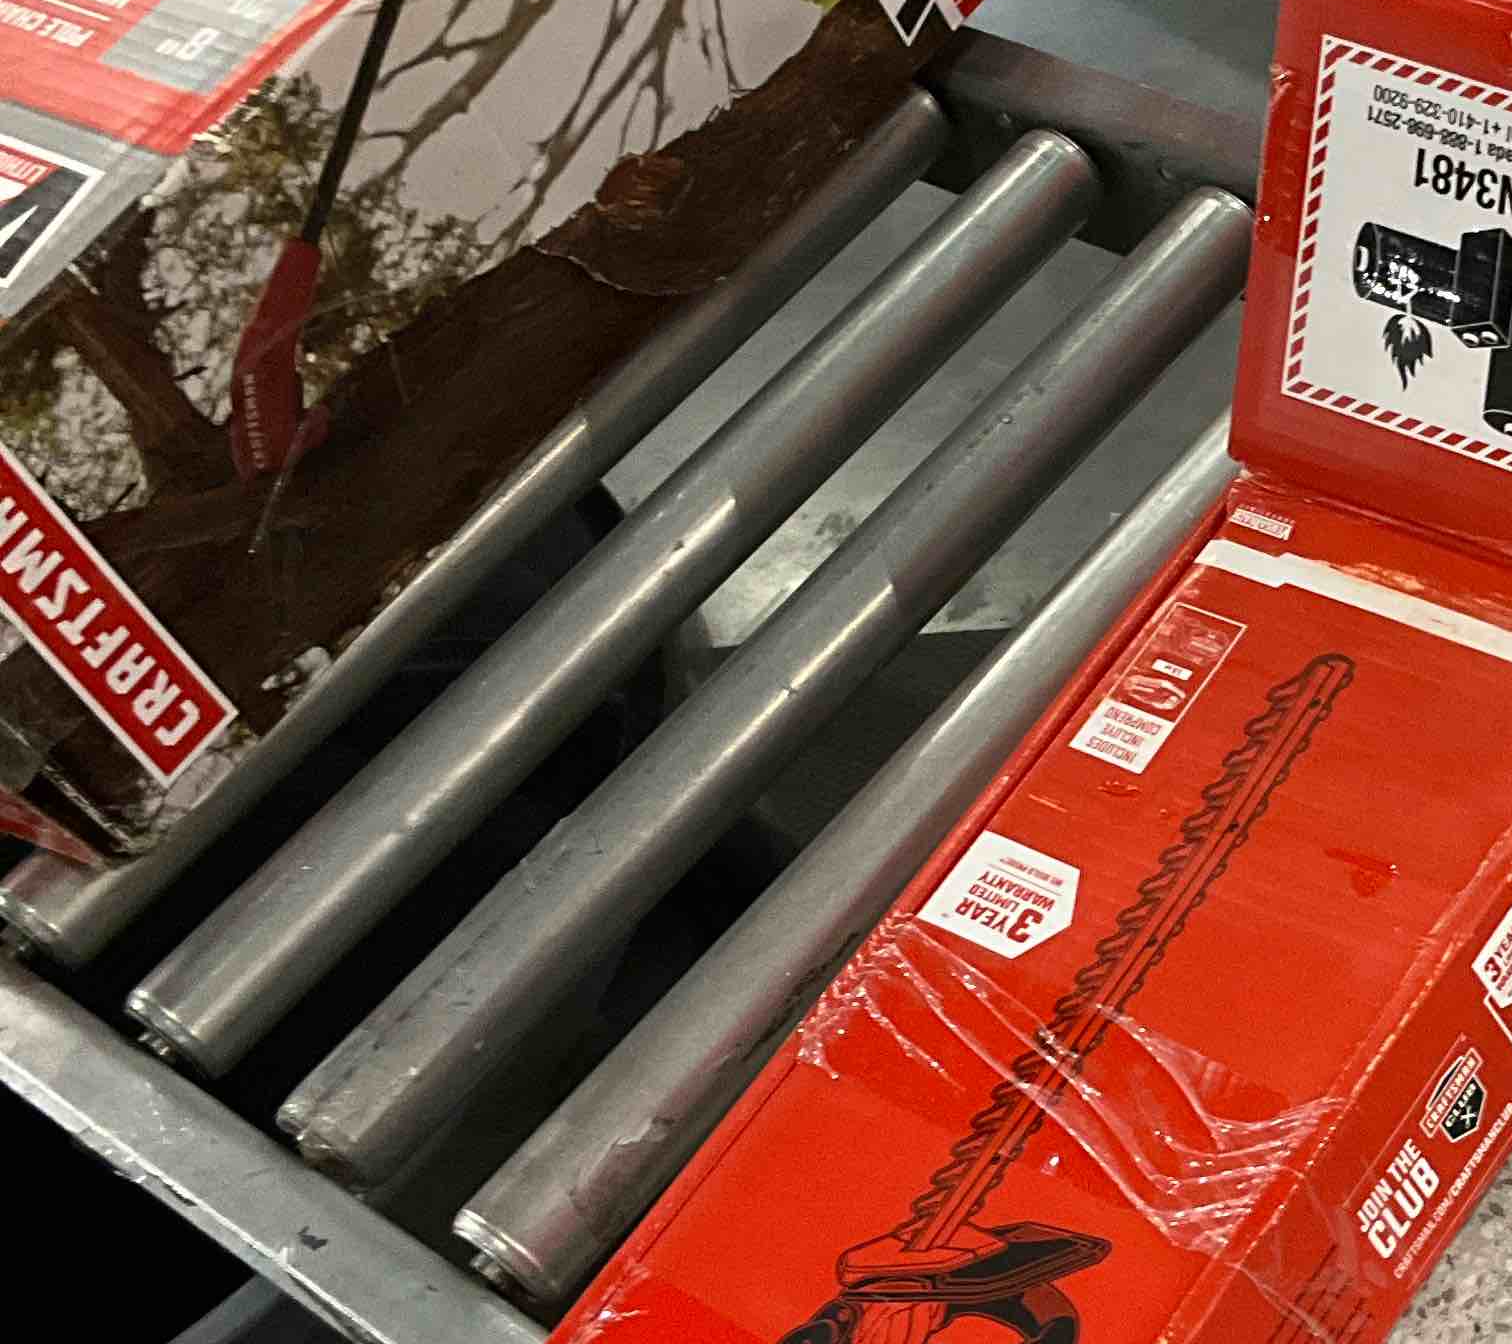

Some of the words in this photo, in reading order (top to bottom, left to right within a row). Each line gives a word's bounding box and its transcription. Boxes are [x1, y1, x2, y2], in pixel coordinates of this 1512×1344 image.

[34, 15, 94, 48] POLE
[156, 26, 220, 61] 8"
[1373, 83, 1501, 136] +1-410-329-9200
[1084, 733, 1139, 764] INCLUDES
[965, 882, 1022, 913] LIMITED
[973, 869, 1059, 911] WARRANTY
[950, 896, 1014, 933] YEAR
[1002, 906, 1047, 945] 3
[1481, 953, 1505, 984] 3
[1424, 1051, 1478, 1133] CRAFTSMAN
[1444, 1079, 1478, 1131] CLUB
[1355, 1170, 1394, 1238] JOIN
[1385, 1131, 1421, 1192] THE
[1366, 1147, 1441, 1272] CLUB
